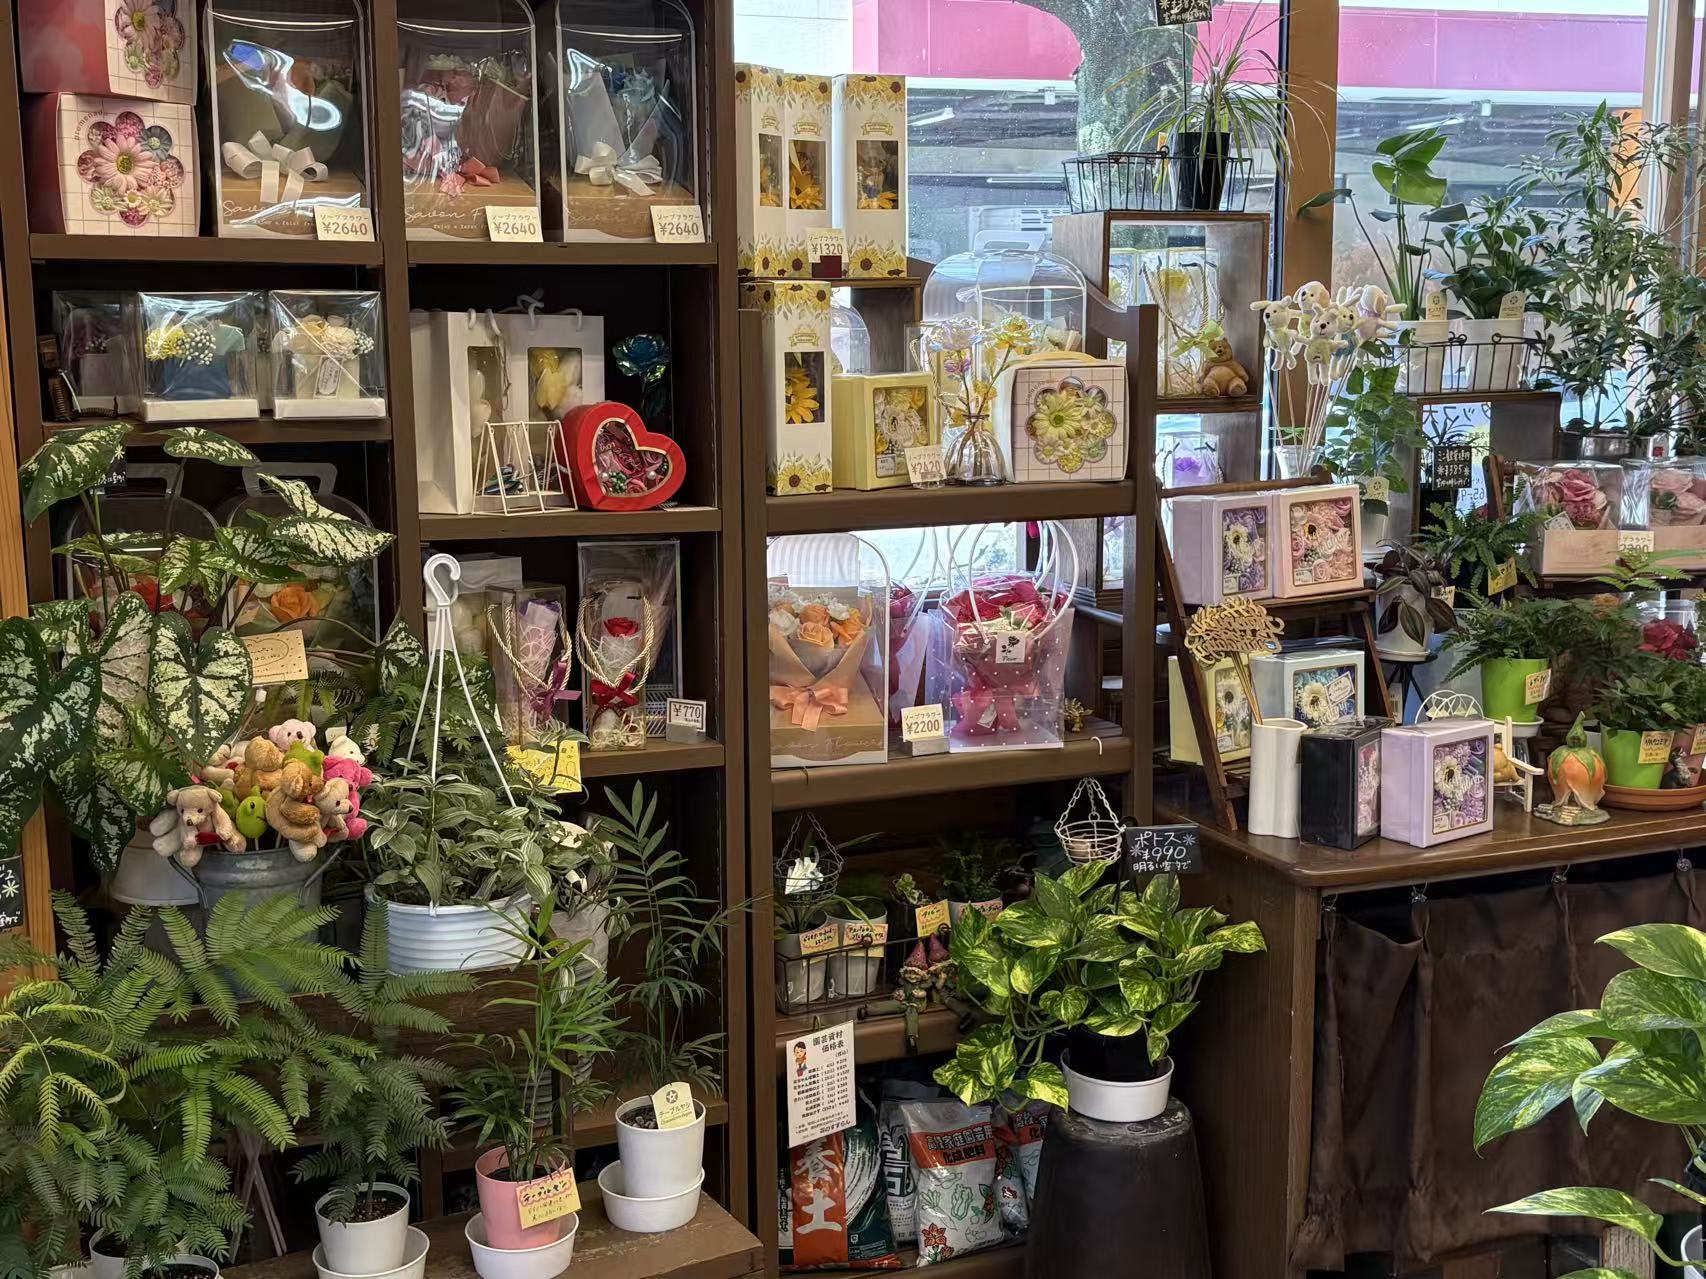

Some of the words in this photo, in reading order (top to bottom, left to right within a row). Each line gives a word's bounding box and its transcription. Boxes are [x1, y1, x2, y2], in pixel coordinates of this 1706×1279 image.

[322, 222, 368, 236] ¥2640
[493, 222, 537, 236] ¥2640
[659, 222, 700, 236] ¥2640
[811, 243, 844, 255] ¥1320
[672, 703, 701, 719] ¥770
[906, 719, 940, 735] ¥2200
[1134, 831, 1182, 848] ポトス
[1141, 845, 1187, 862] ¥990
